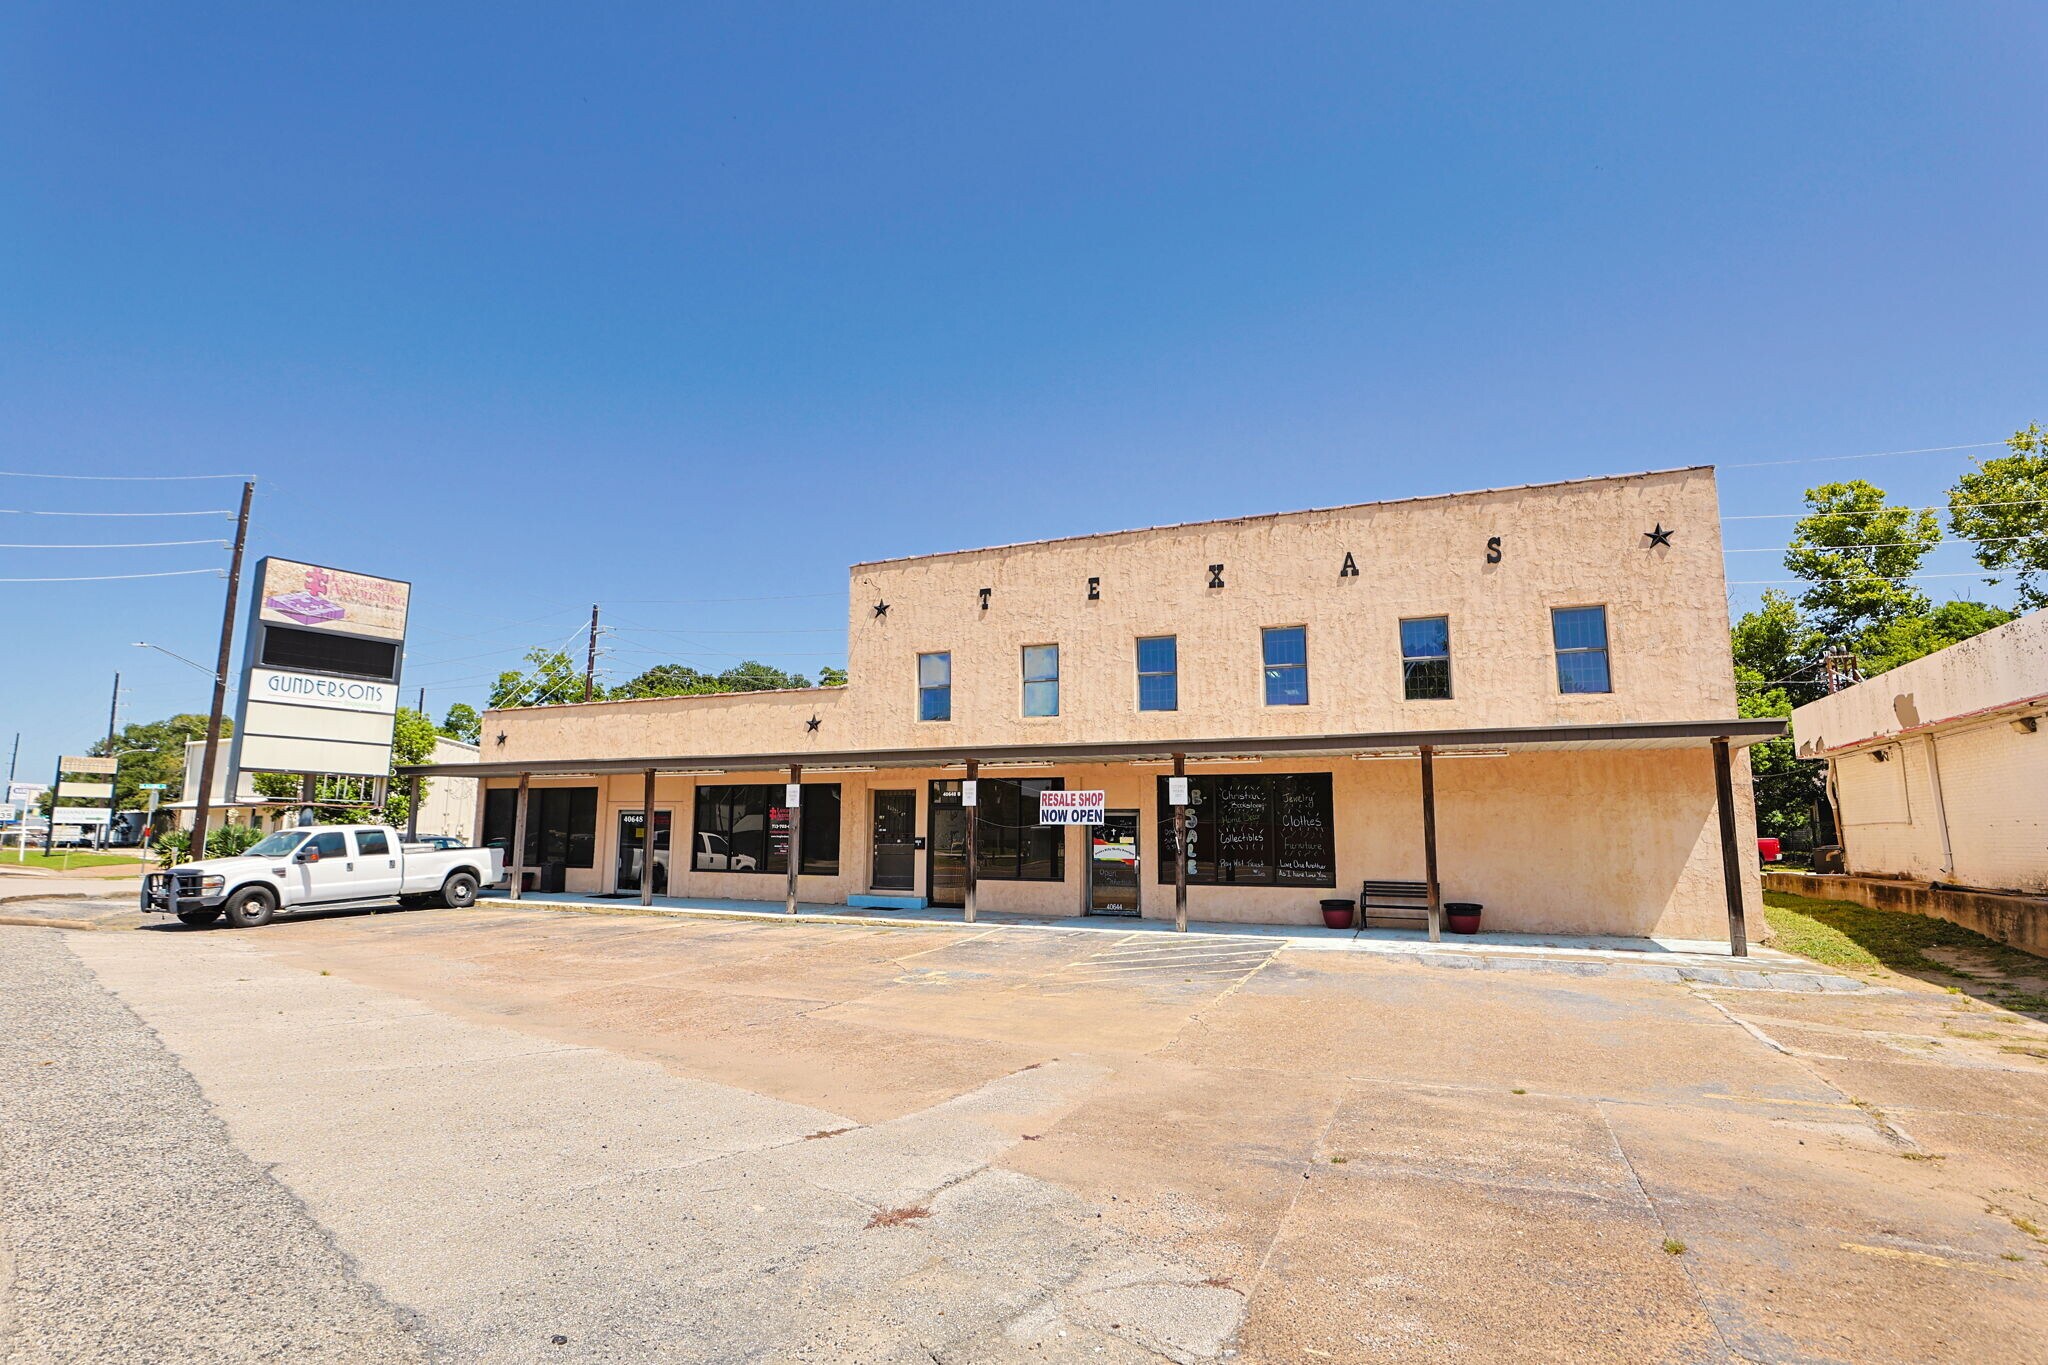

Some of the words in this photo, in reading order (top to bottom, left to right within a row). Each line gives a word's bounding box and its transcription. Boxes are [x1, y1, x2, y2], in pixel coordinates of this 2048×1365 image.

[980, 536, 1502, 610] TEXAS
[268, 675, 383, 702] GUNDERSONS
[1041, 793, 1076, 807] RESALE
[1078, 793, 1104, 807] SHOP
[1282, 793, 1314, 808] Jewelry
[623, 815, 644, 823] 40648
[1041, 809, 1068, 823] NOW
[1071, 809, 1103, 823] OPEN
[1282, 814, 1322, 827] Clothes
[1220, 832, 1264, 844] Collectibles
